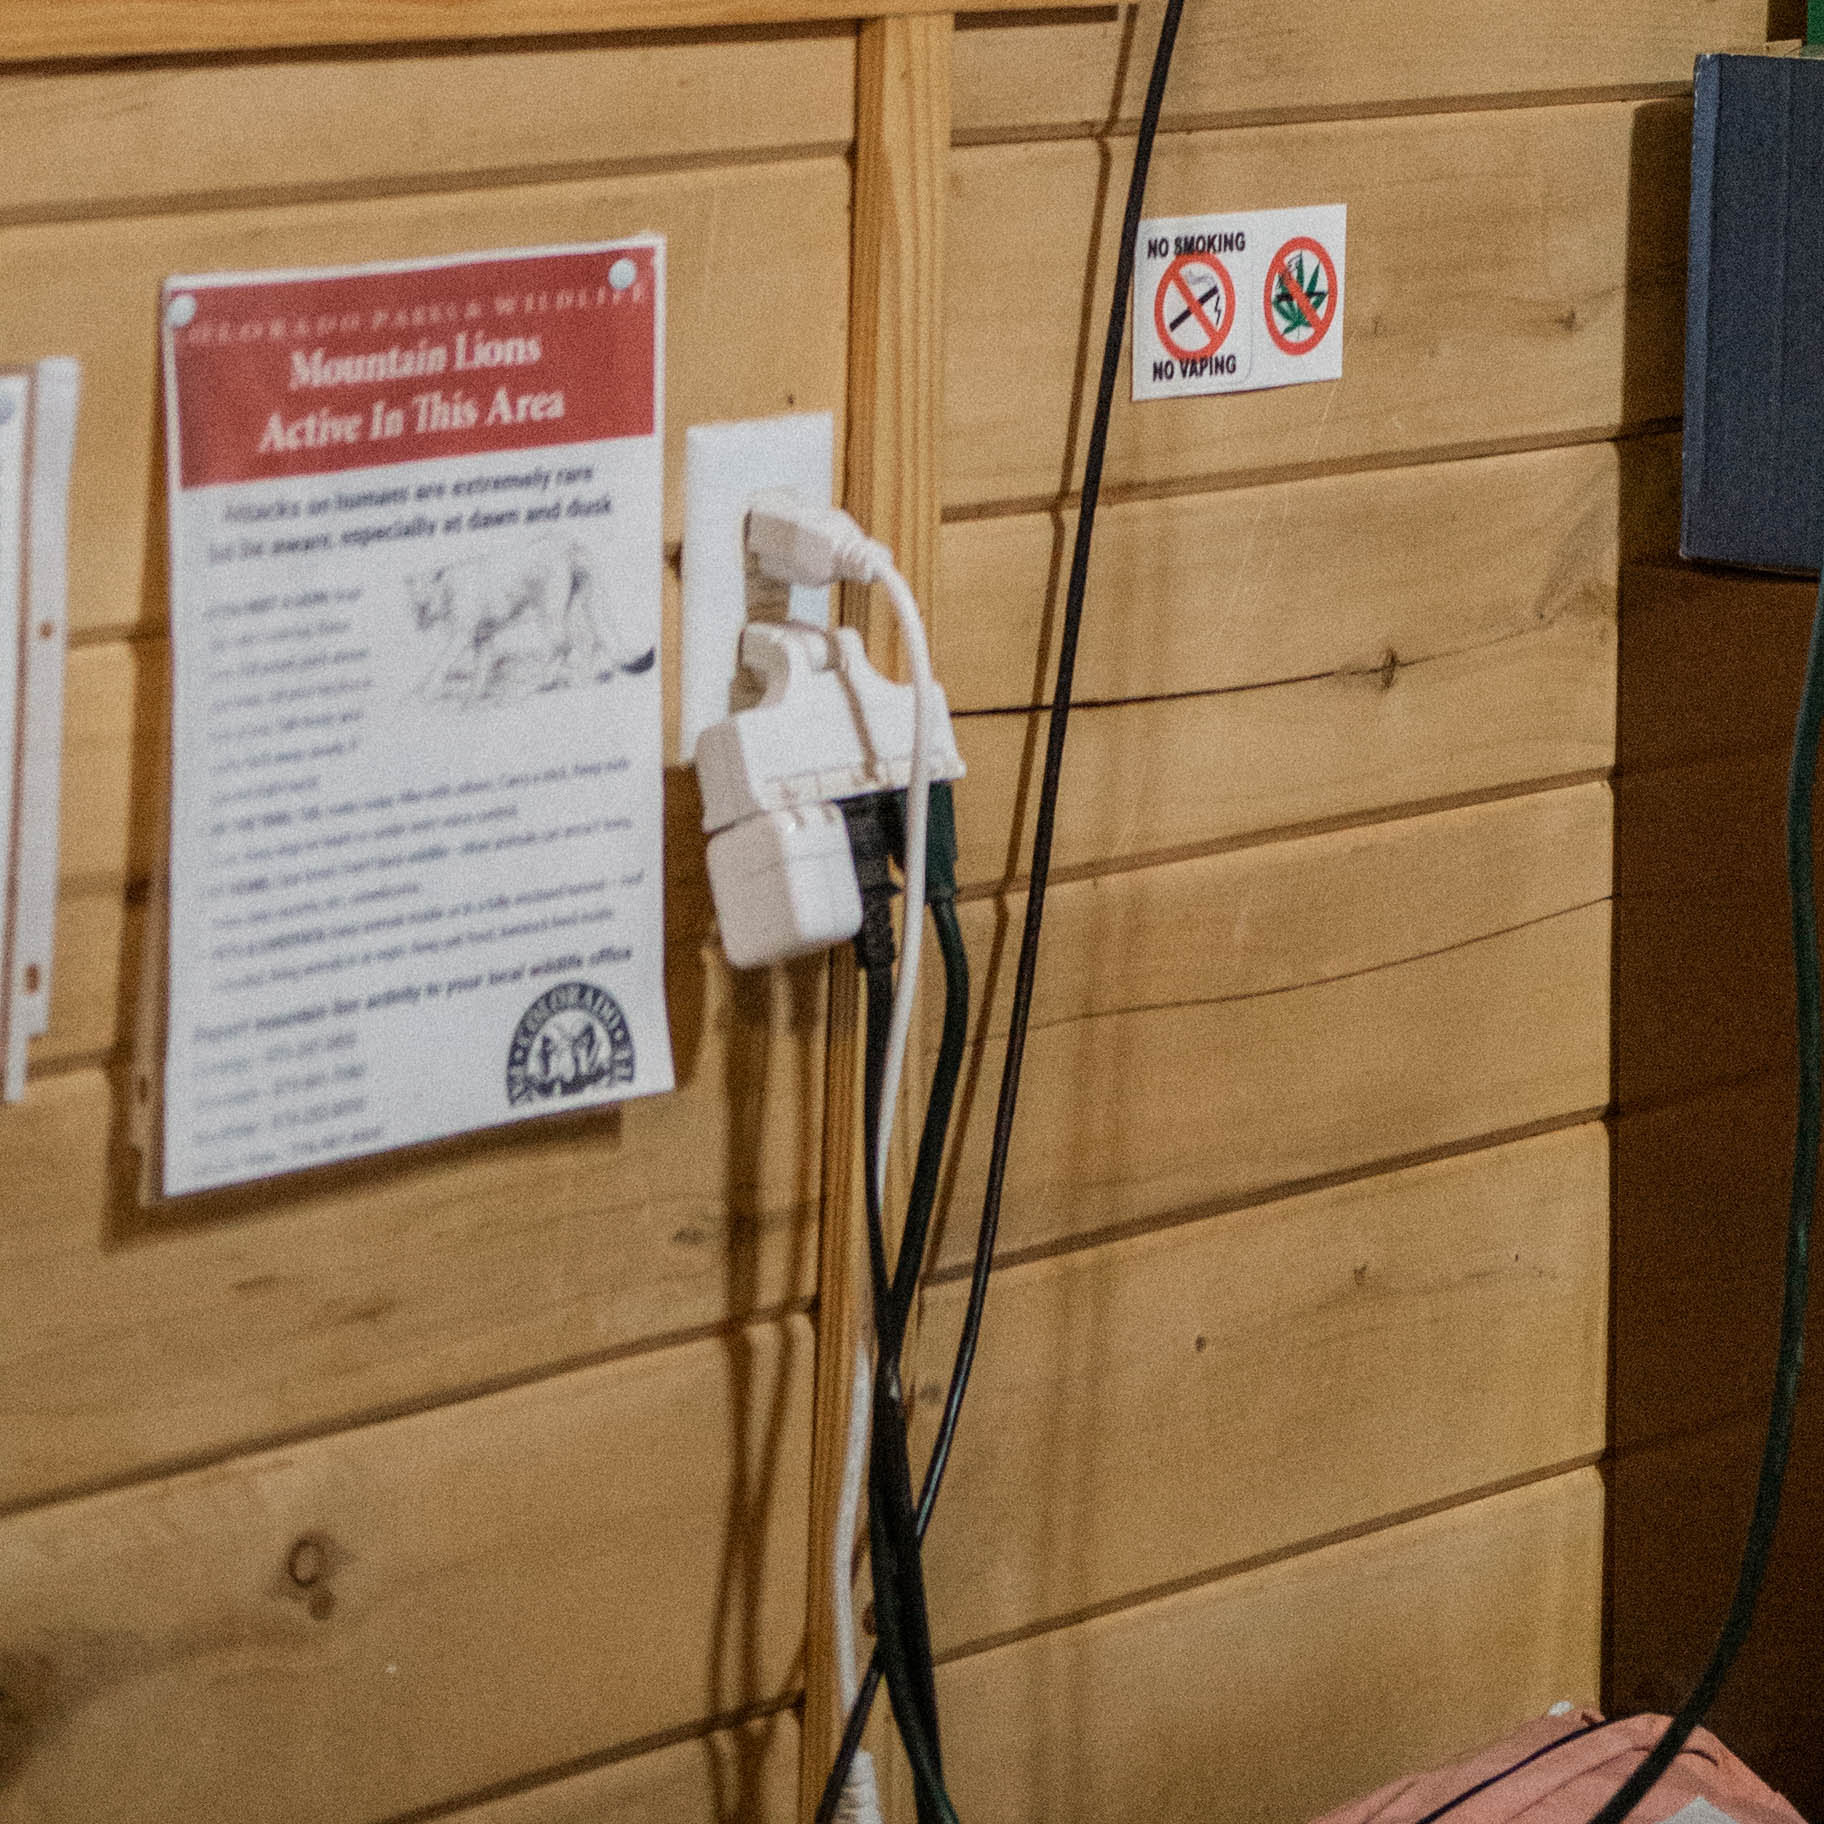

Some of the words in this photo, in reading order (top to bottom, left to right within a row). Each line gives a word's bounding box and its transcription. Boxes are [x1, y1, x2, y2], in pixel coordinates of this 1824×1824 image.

[1147, 238, 1169, 259] NO
[1173, 231, 1246, 255] SMOKING
[288, 340, 447, 392] Mountain
[452, 332, 542, 372] Lions
[1152, 360, 1175, 382] NO
[1180, 354, 1238, 379] VAPING
[258, 408, 364, 454] Active
[370, 400, 404, 440] In
[411, 390, 478, 433] This
[484, 386, 566, 426] Area
[333, 485, 409, 513] humans
[414, 483, 447, 502] are
[451, 467, 551, 496] extremely
[555, 465, 594, 485] rare
[340, 516, 437, 547] especially
[442, 515, 464, 534] at
[467, 506, 520, 531] dawn
[524, 503, 561, 524] and
[565, 495, 613, 518] dusk
